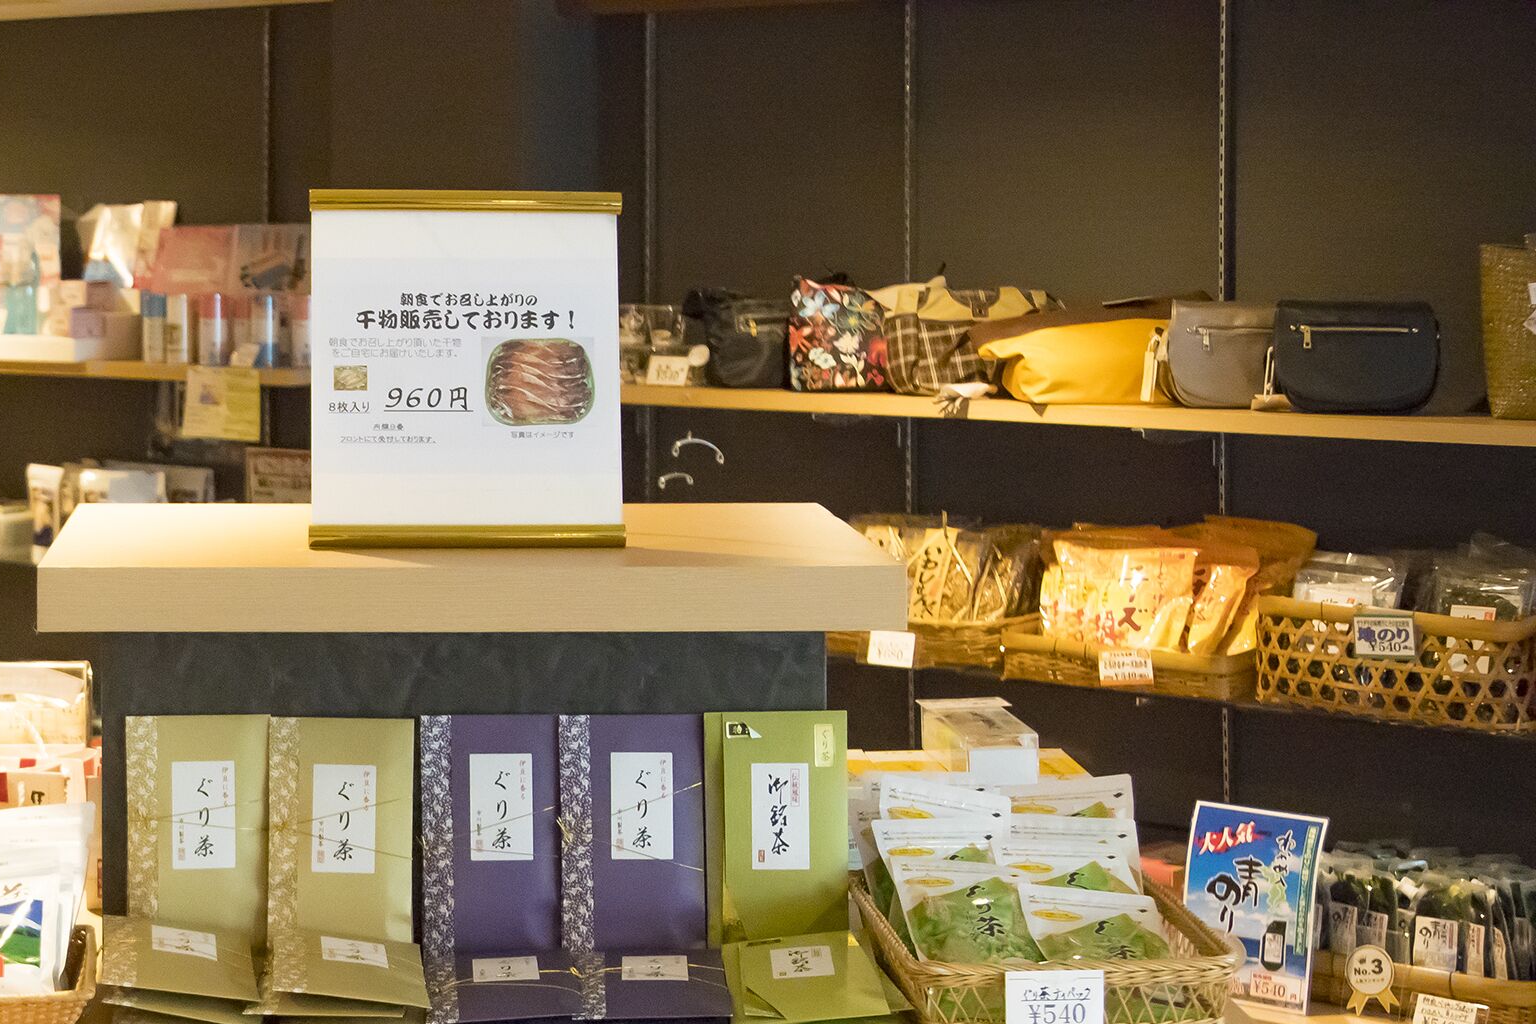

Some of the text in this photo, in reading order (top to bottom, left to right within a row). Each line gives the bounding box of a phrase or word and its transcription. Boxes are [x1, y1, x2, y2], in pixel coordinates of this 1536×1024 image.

[400, 293, 537, 306] 朝食でお召し上がりの
[356, 309, 573, 330] 干物販売しております！
[329, 338, 462, 347] 朝食でお召し上がり頂いた干物
[332, 348, 458, 358] をご自宅にお届けいたします。
[328, 387, 467, 413] 8枚入り 960円
[195, 778, 214, 857] ぐり茶
[333, 781, 354, 861] ぐり茶
[492, 771, 512, 849] ぐり茶
[632, 769, 652, 849] ぐり茶
[768, 773, 790, 856] 御銘茶
[1199, 821, 1256, 855] 大人気
[1205, 854, 1264, 934] 青のり
[1353, 958, 1384, 977] No.3
[1028, 1003, 1086, 1024] ¥540
